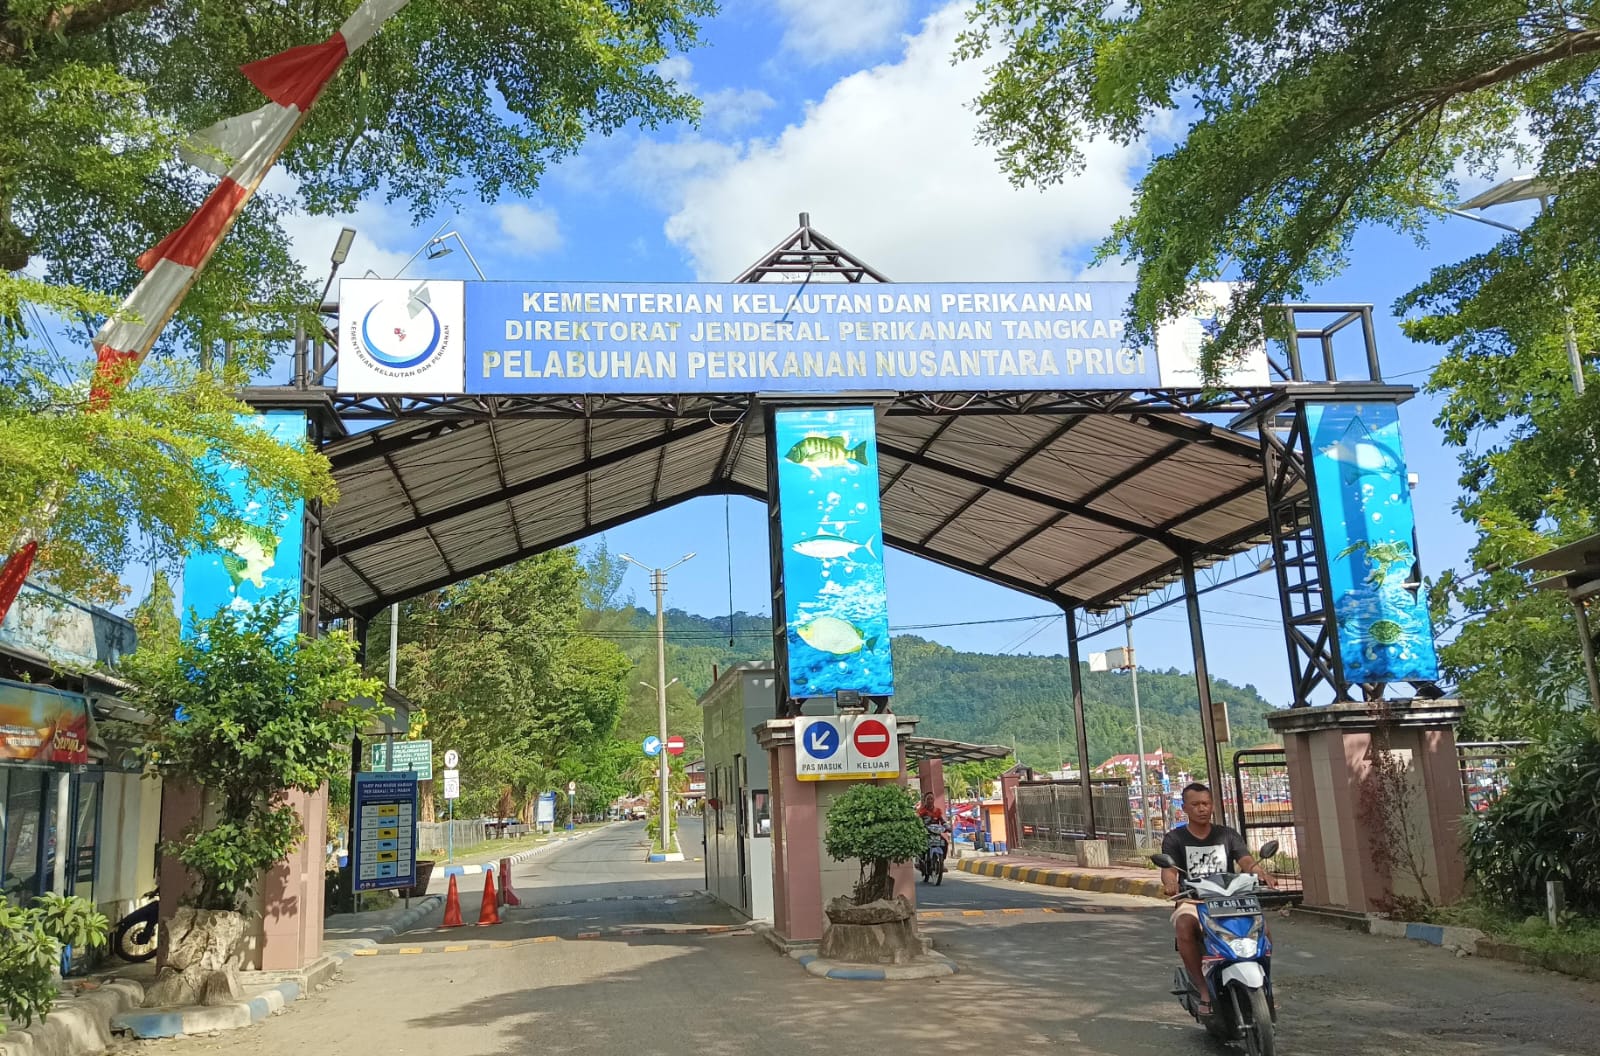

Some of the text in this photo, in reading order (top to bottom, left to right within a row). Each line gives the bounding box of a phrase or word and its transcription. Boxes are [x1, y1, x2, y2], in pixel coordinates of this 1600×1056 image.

[523, 292, 1093, 314] KEMENTERIAN KELAUTAN DAN PERIKANAN
[505, 319, 1124, 342] DIREKTORAT JENDERAL PERIKANAN TANGKAP
[350, 321, 450, 378] KEMENTERIAN KELAUTAN DAN PERIKANAN
[482, 348, 1146, 379] PELABUHAN PERIKANAN NUSANTARA PRIGI
[801, 763, 843, 771] PAS MASUK
